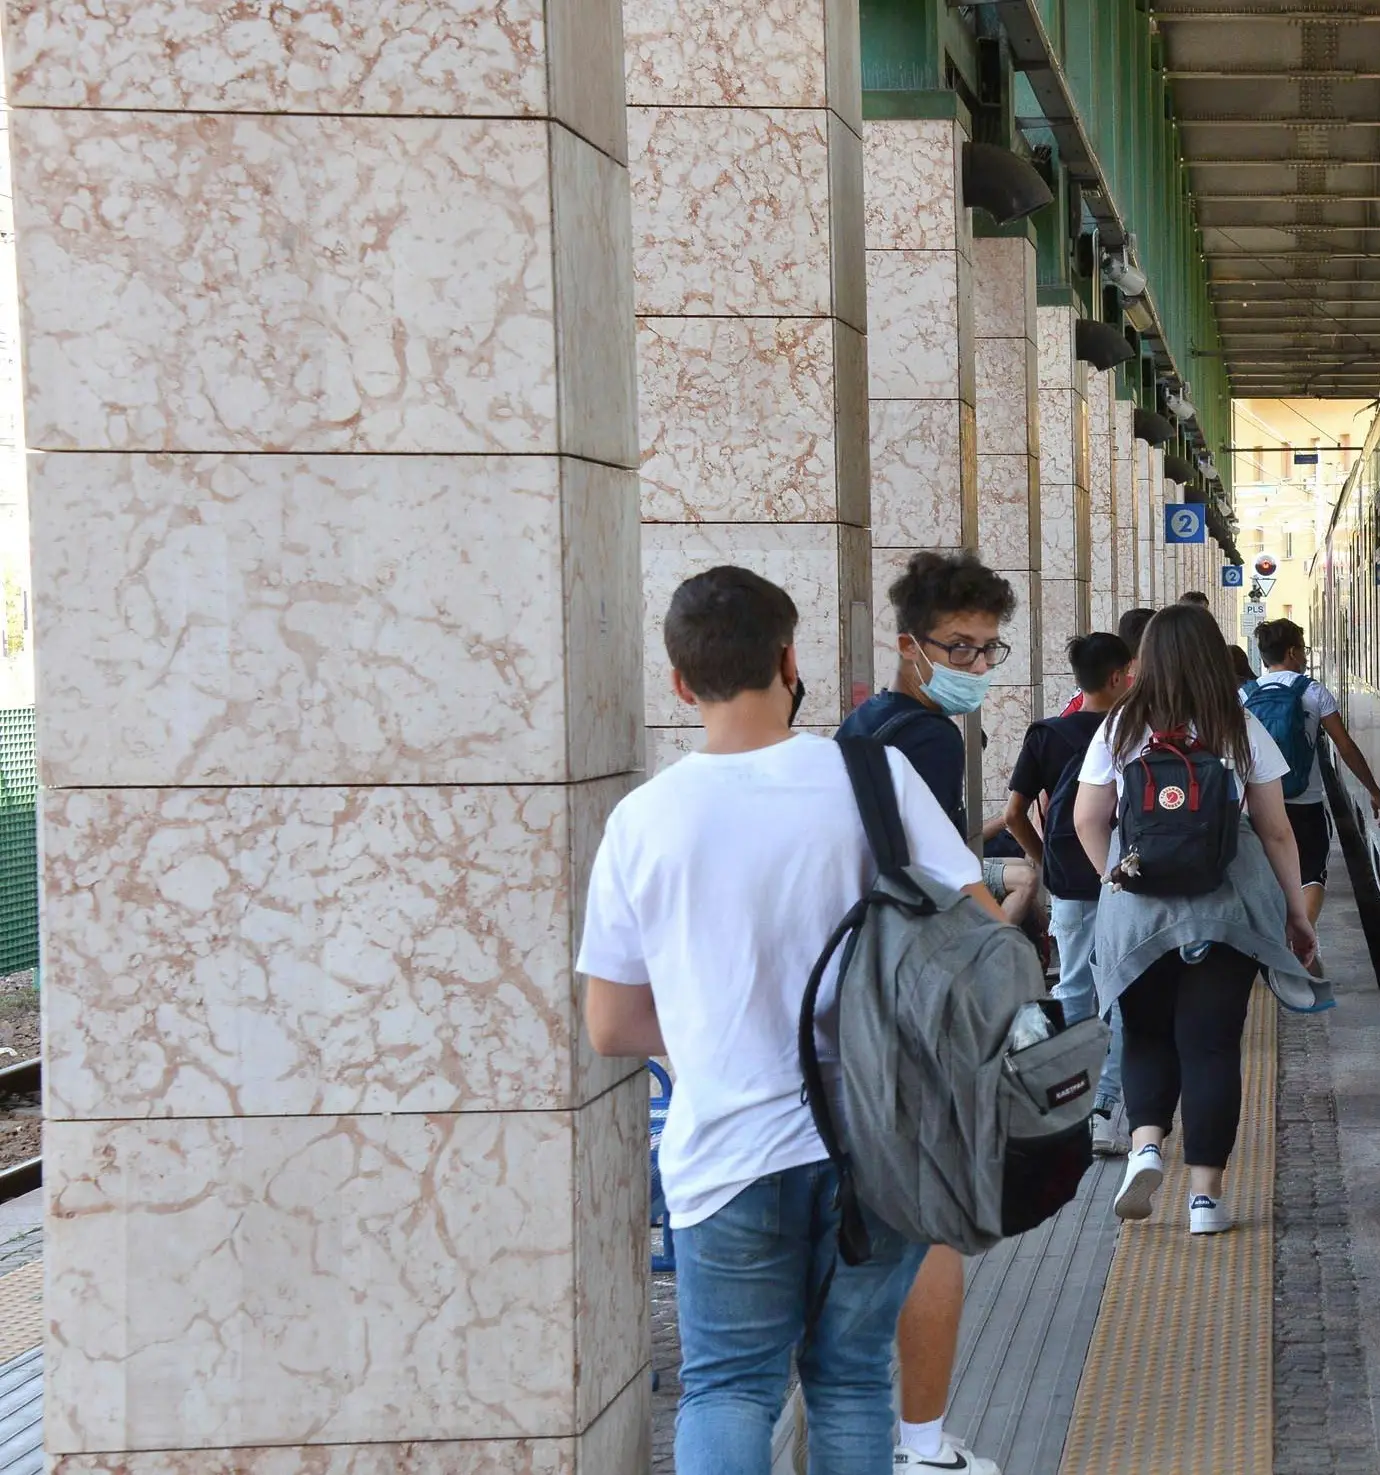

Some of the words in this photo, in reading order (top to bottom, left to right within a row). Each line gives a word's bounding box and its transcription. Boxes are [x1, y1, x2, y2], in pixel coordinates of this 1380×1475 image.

[1178, 514, 1192, 532] 2
[1229, 572, 1237, 582] 2
[1247, 605, 1264, 614] PLS
